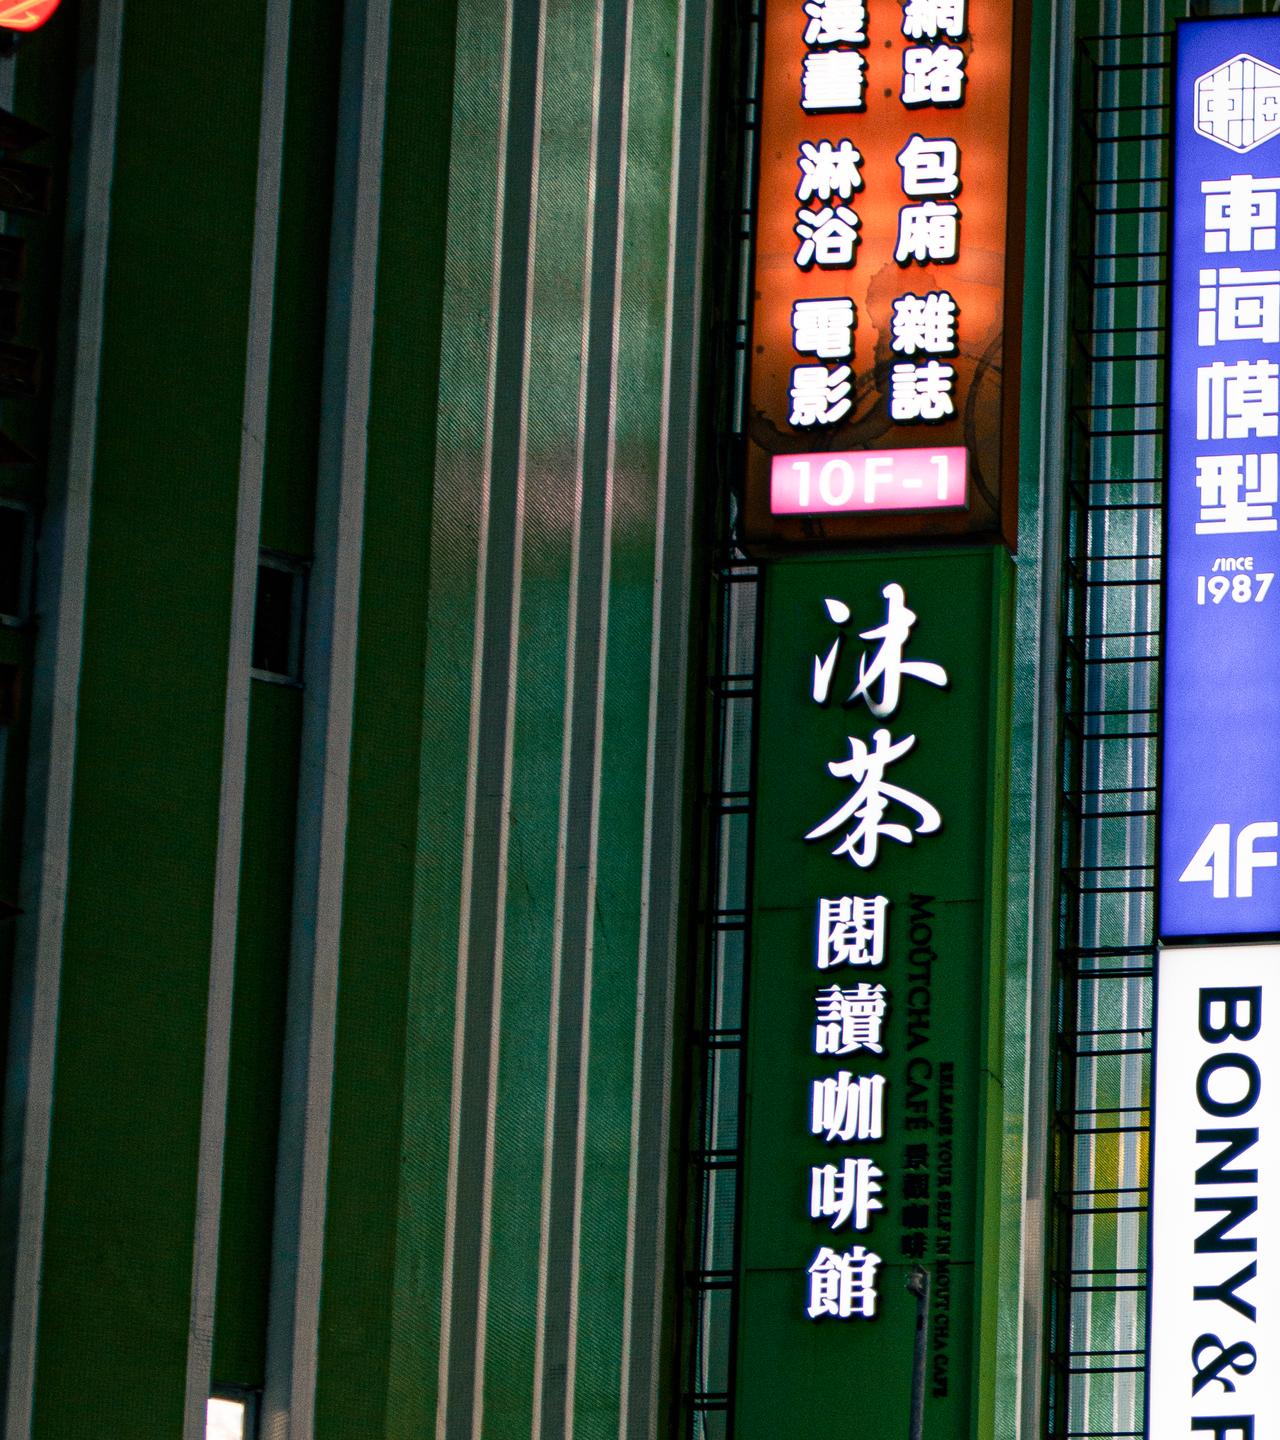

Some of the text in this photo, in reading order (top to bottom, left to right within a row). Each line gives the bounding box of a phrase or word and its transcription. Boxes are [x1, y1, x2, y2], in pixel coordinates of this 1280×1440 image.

[796, 140, 862, 269] 淋浴
[897, 135, 961, 264] 包廂
[789, 298, 855, 427] 電影
[891, 292, 957, 422] 雜誌
[792, 454, 949, 507] 10F-1
[1196, 573, 1275, 605] 1987
[1211, 556, 1253, 572] SINCE
[1178, 822, 1279, 899] 4F
[807, 895, 888, 1320] 閱讀咖啡館
